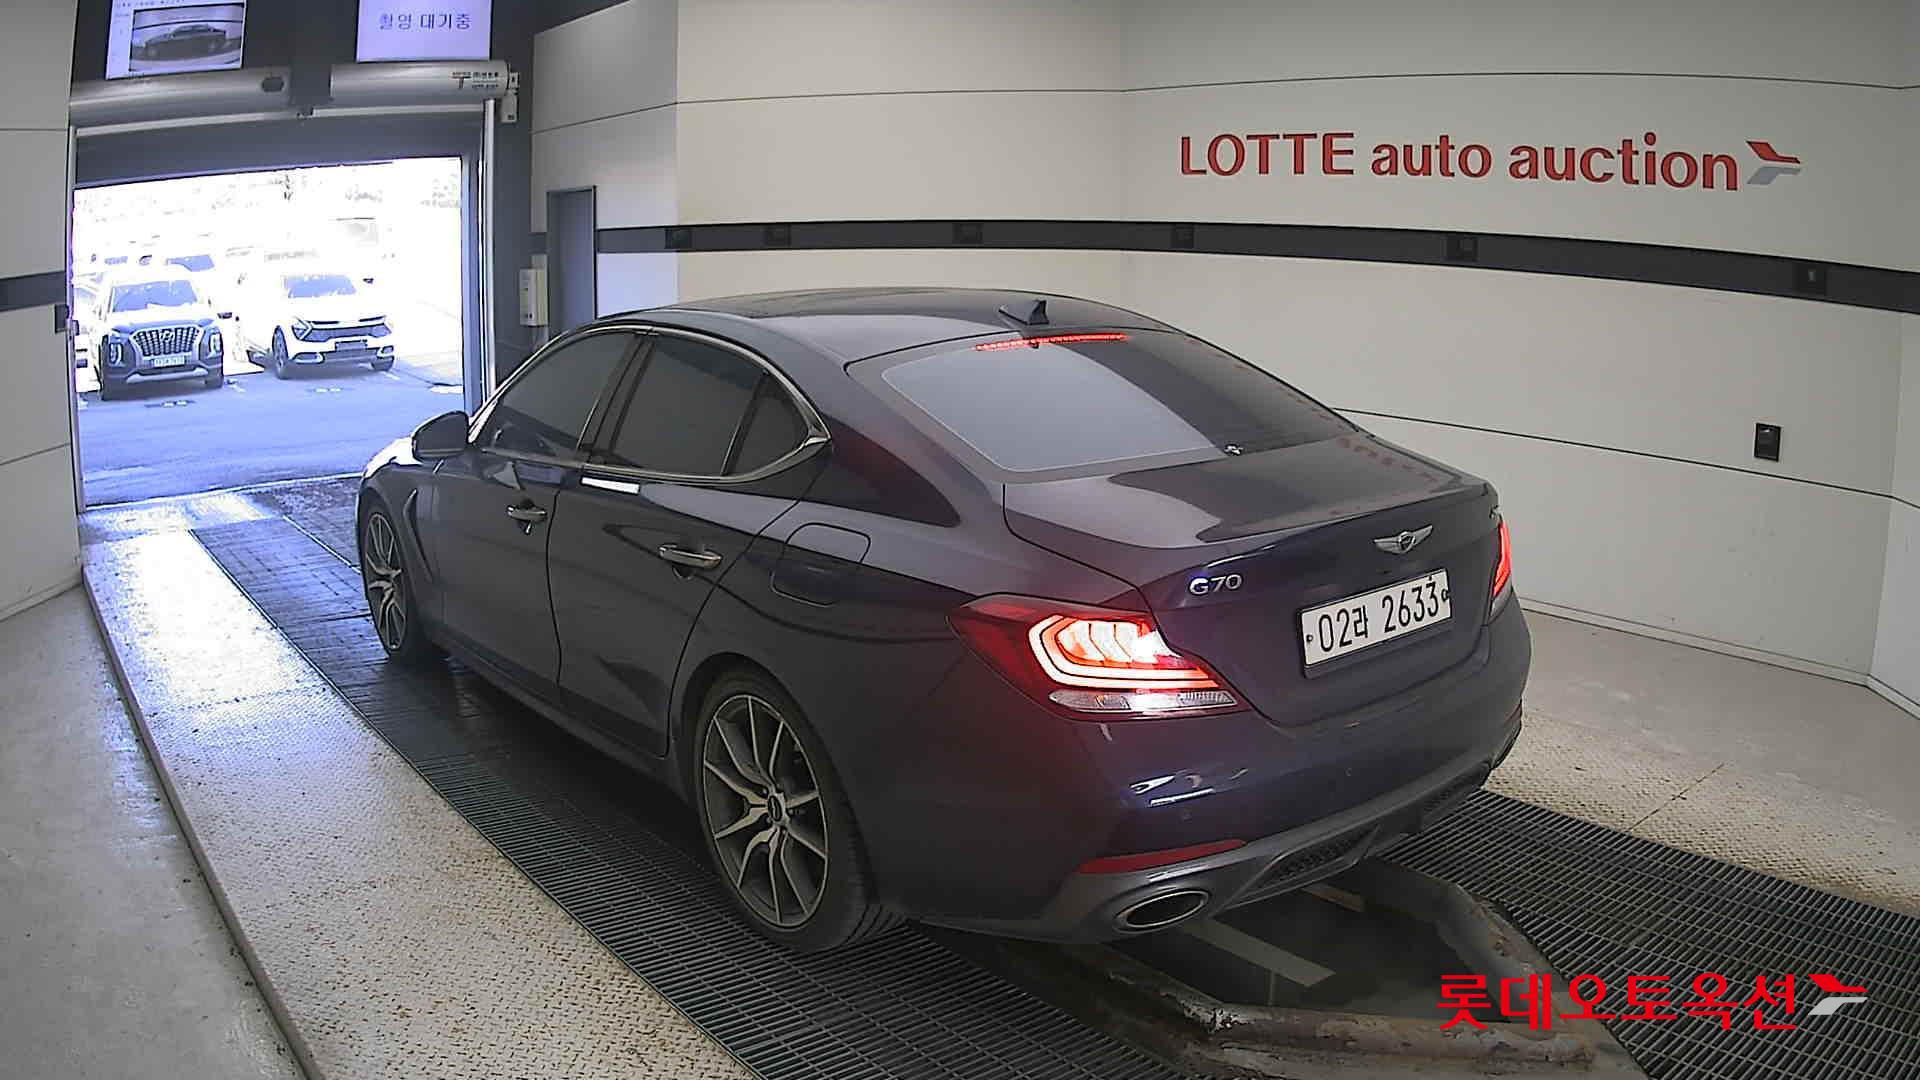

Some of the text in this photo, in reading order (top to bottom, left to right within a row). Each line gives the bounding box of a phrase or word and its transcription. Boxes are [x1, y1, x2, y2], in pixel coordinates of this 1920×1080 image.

[420, 13, 472, 30] 대기중
[1181, 131, 1739, 191] LOTTE auto auction
[1189, 573, 1242, 595] G70
[1318, 580, 1439, 652] 02라 2633
